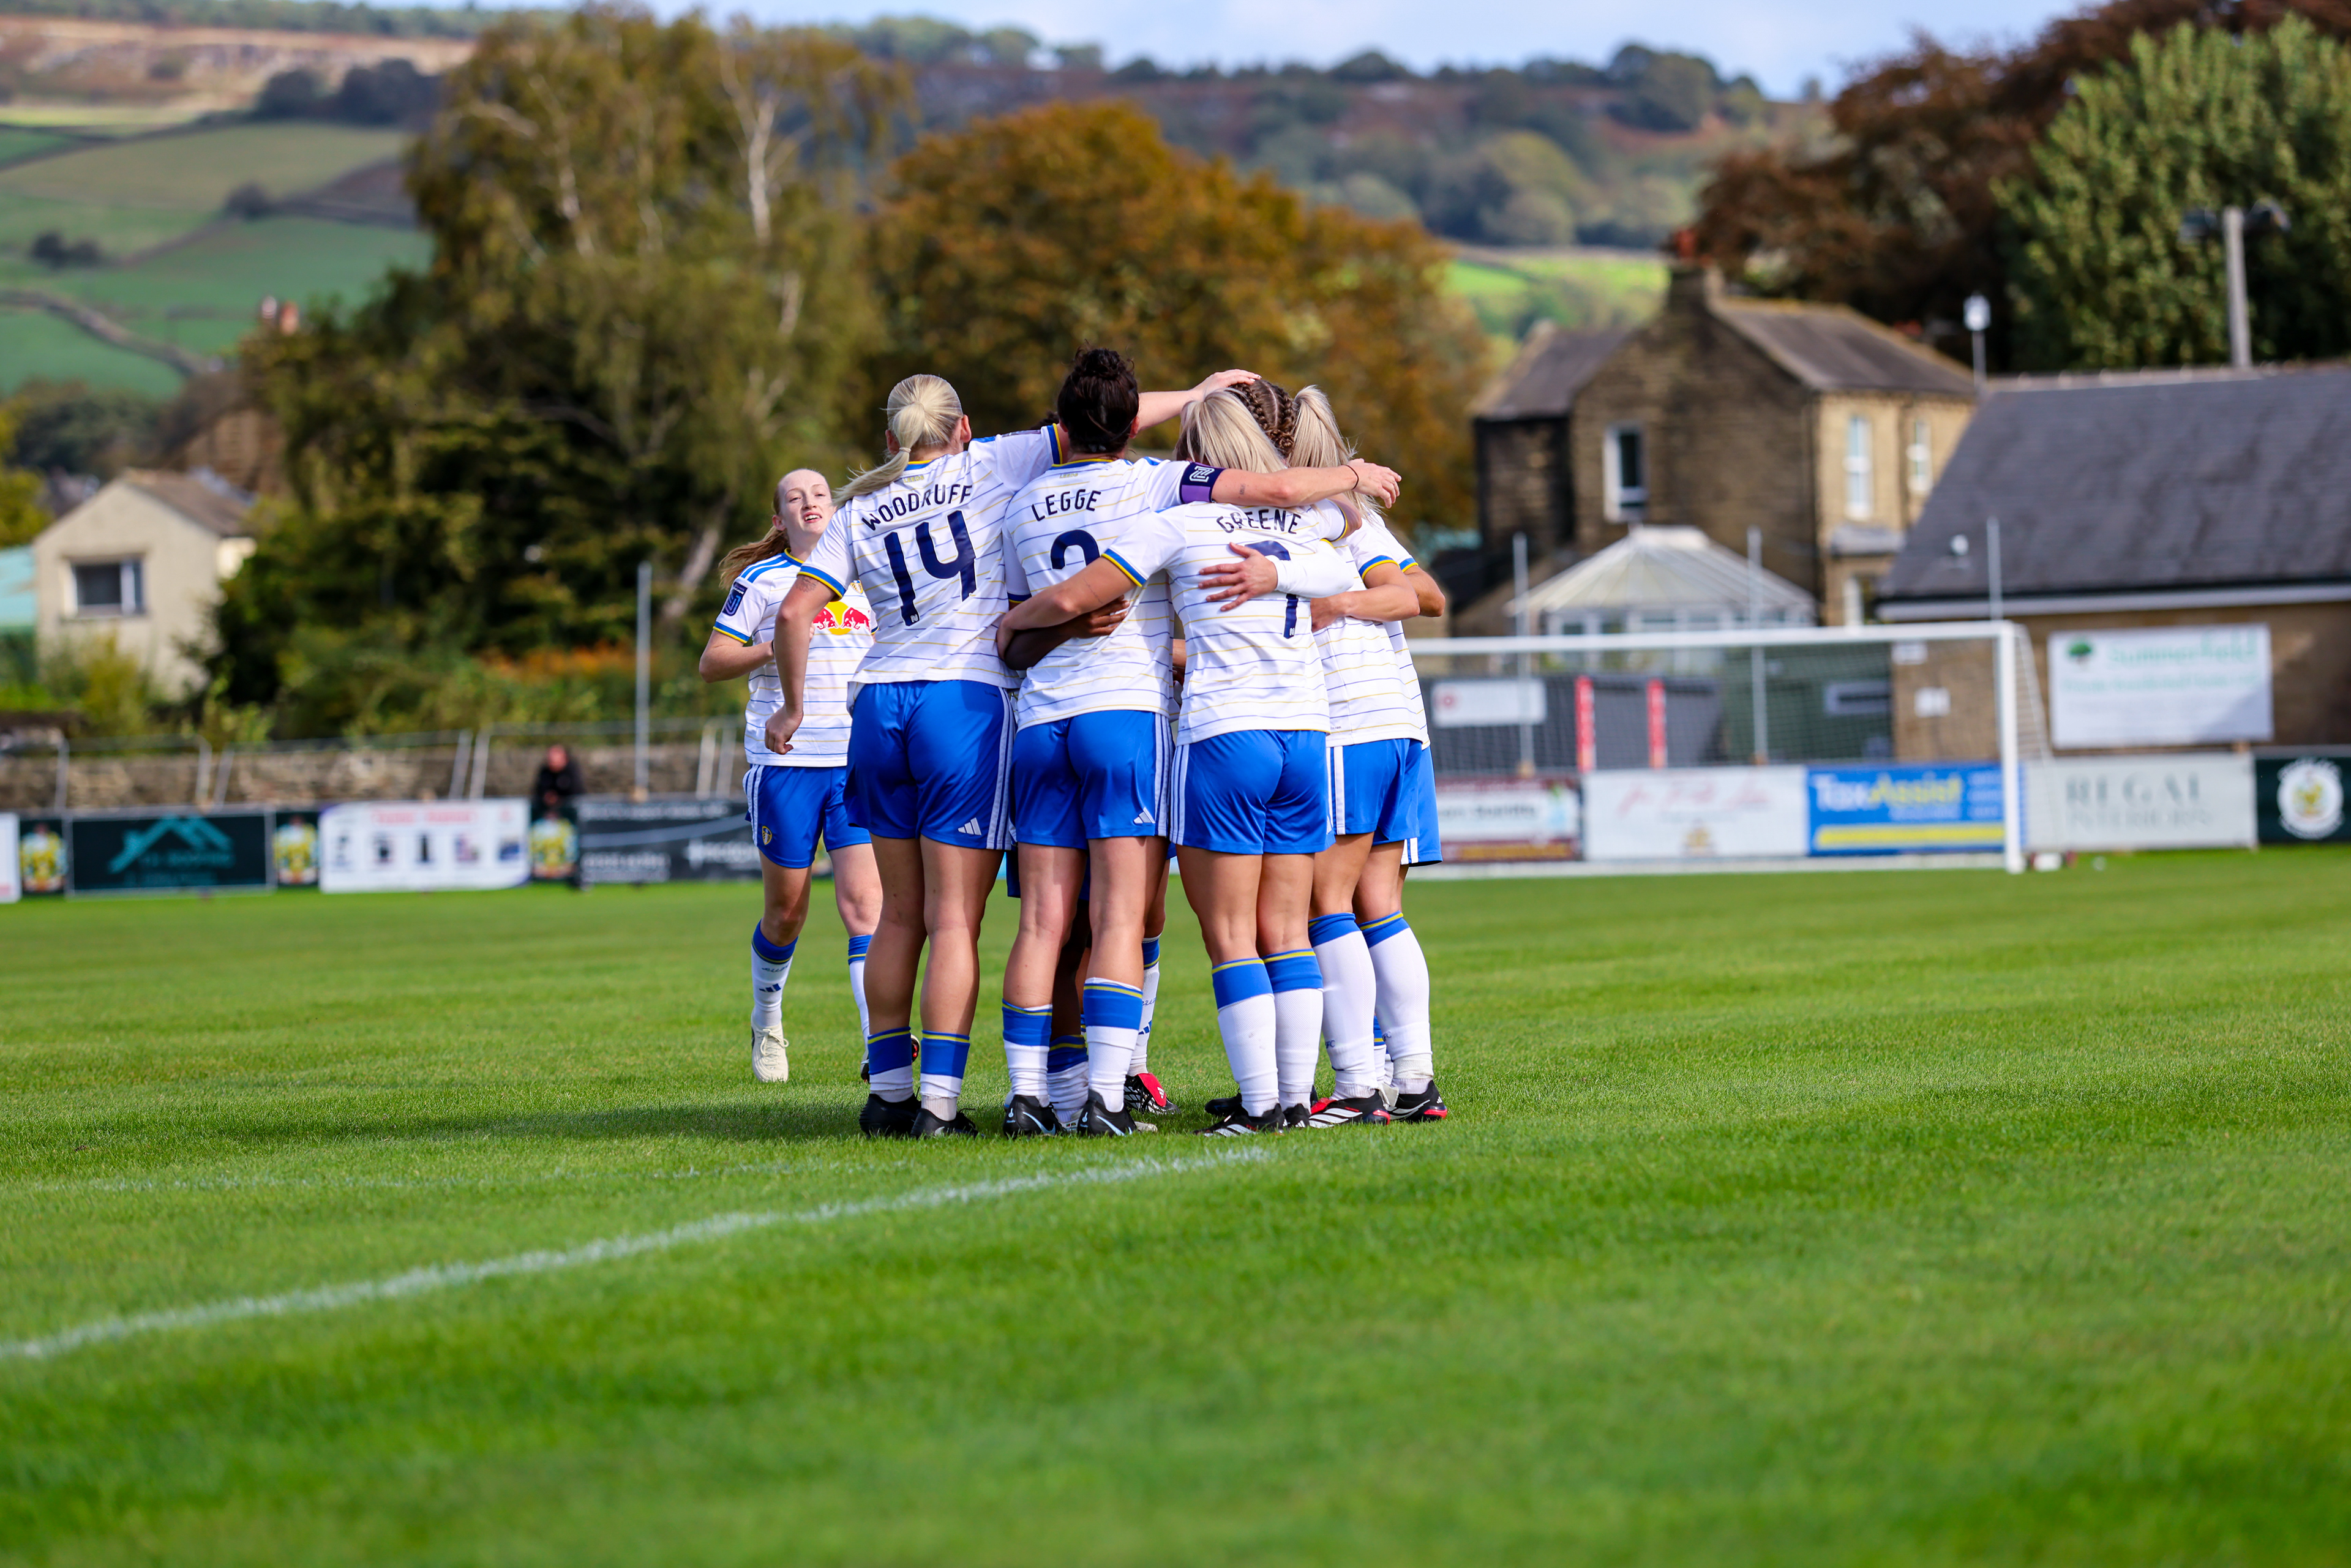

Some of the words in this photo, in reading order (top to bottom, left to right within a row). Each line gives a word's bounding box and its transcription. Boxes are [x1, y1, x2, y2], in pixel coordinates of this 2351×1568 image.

[861, 484, 972, 531] WOODRUFF
[1031, 489, 1101, 522] LEGGE
[1216, 509, 1302, 534] GREENE
[883, 510, 977, 627] 14
